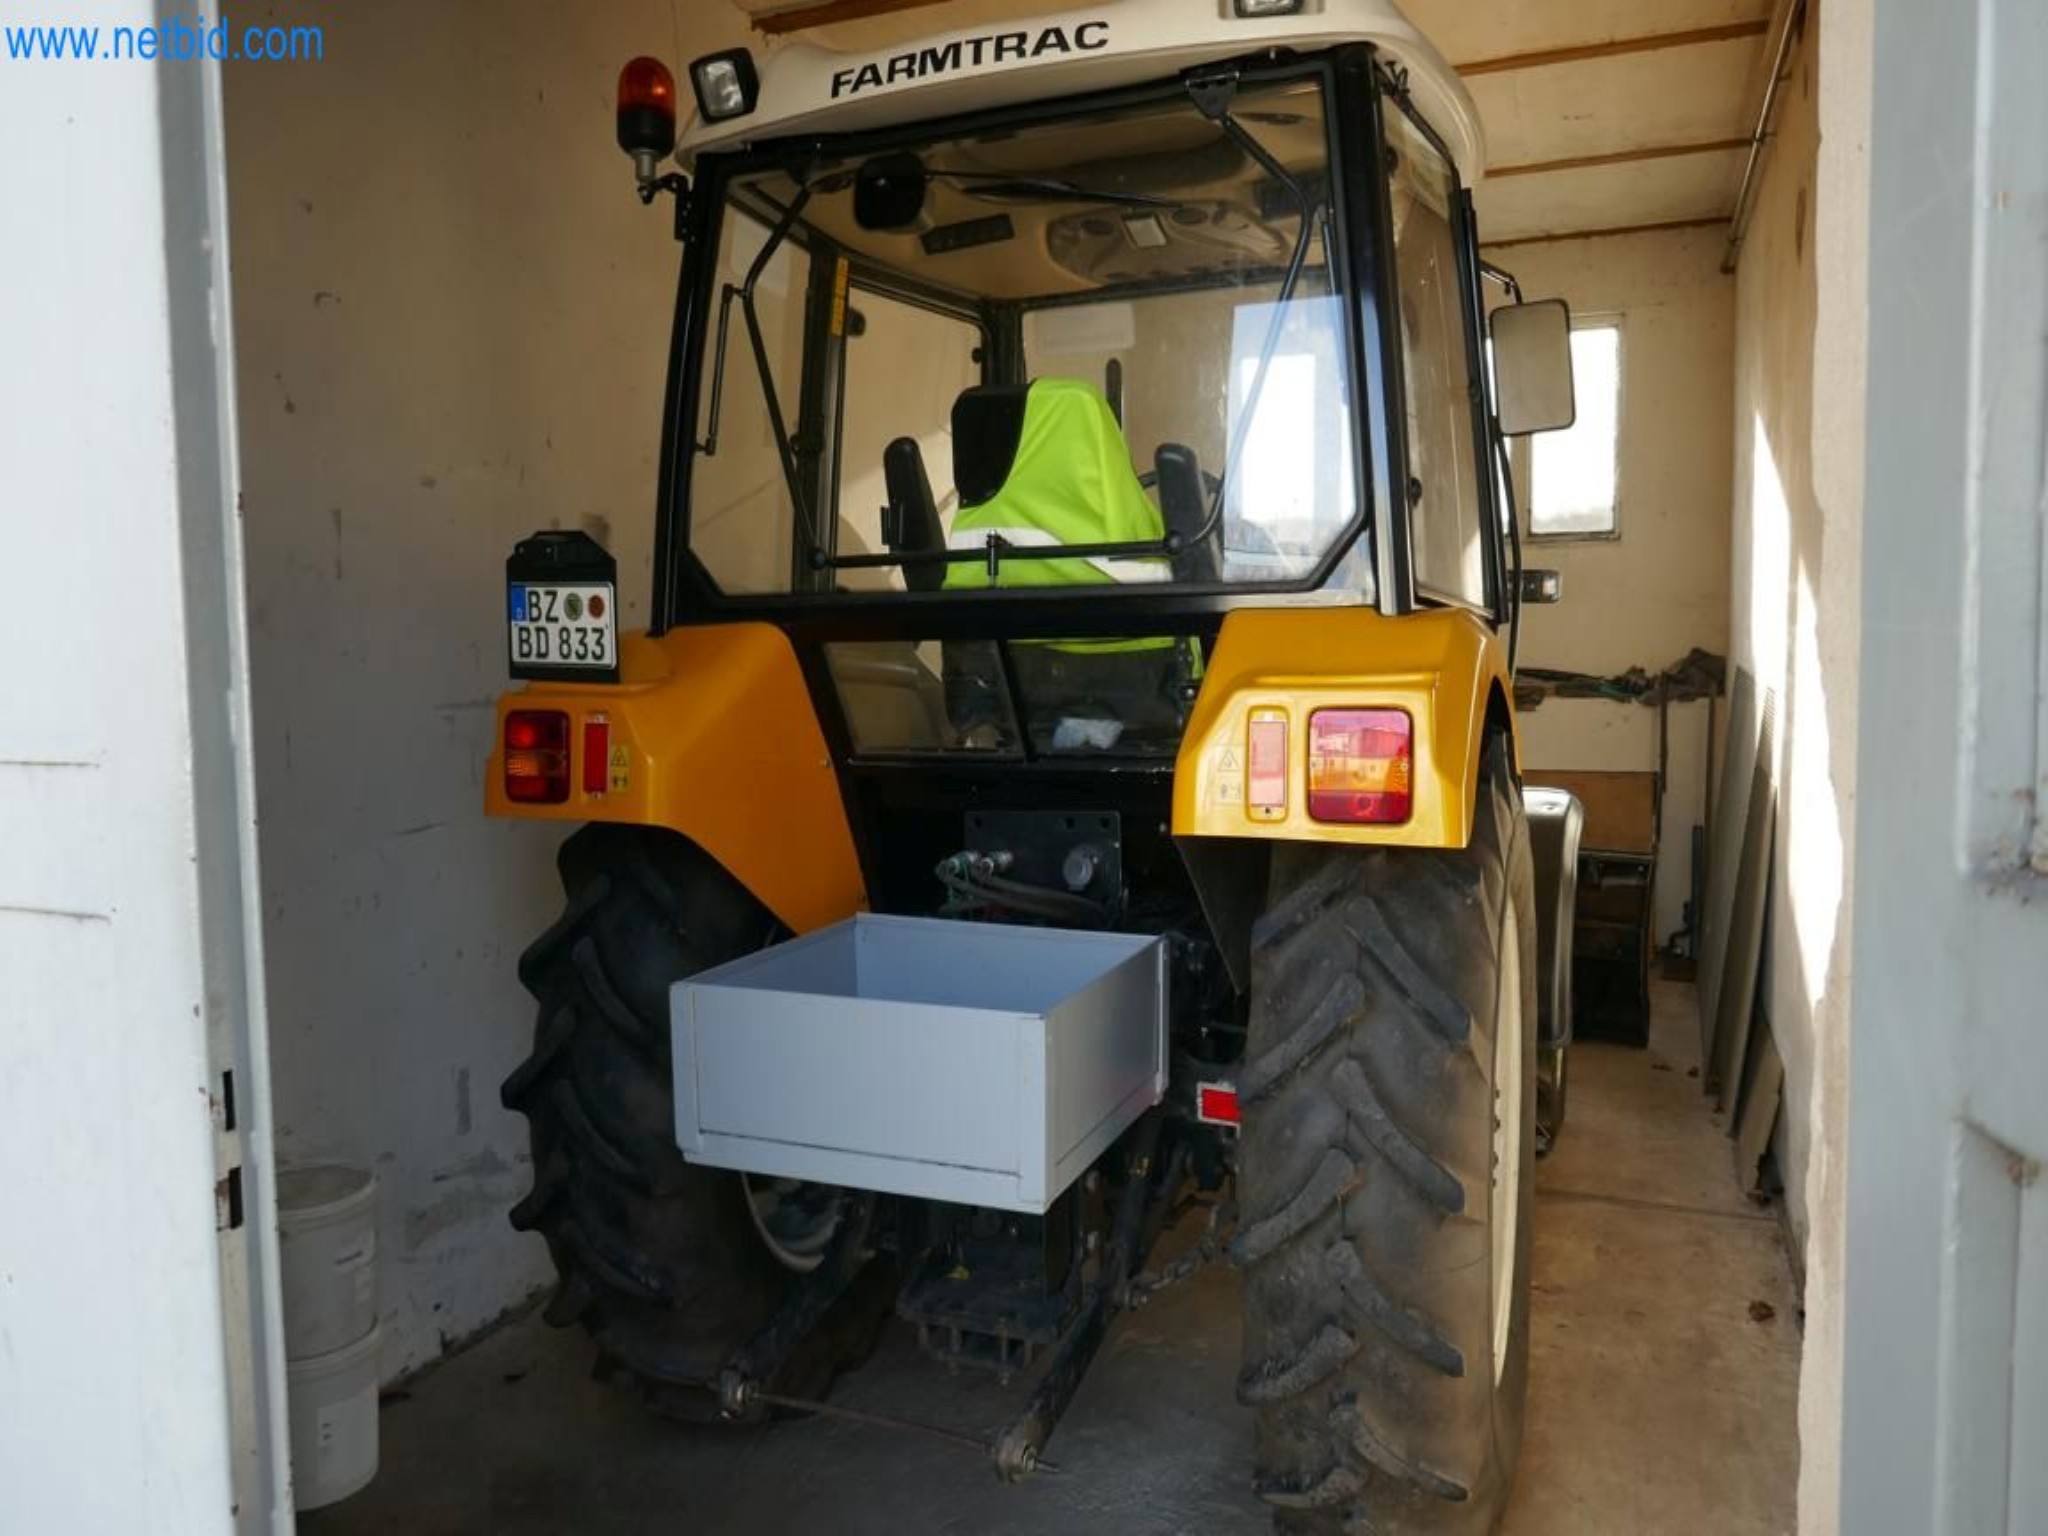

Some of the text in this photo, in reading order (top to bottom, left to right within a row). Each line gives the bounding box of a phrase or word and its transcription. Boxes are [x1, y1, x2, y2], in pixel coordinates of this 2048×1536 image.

[831, 21, 1109, 99] FARMTRAC
[528, 590, 559, 623] BZ
[518, 627, 605, 660] BD 833
